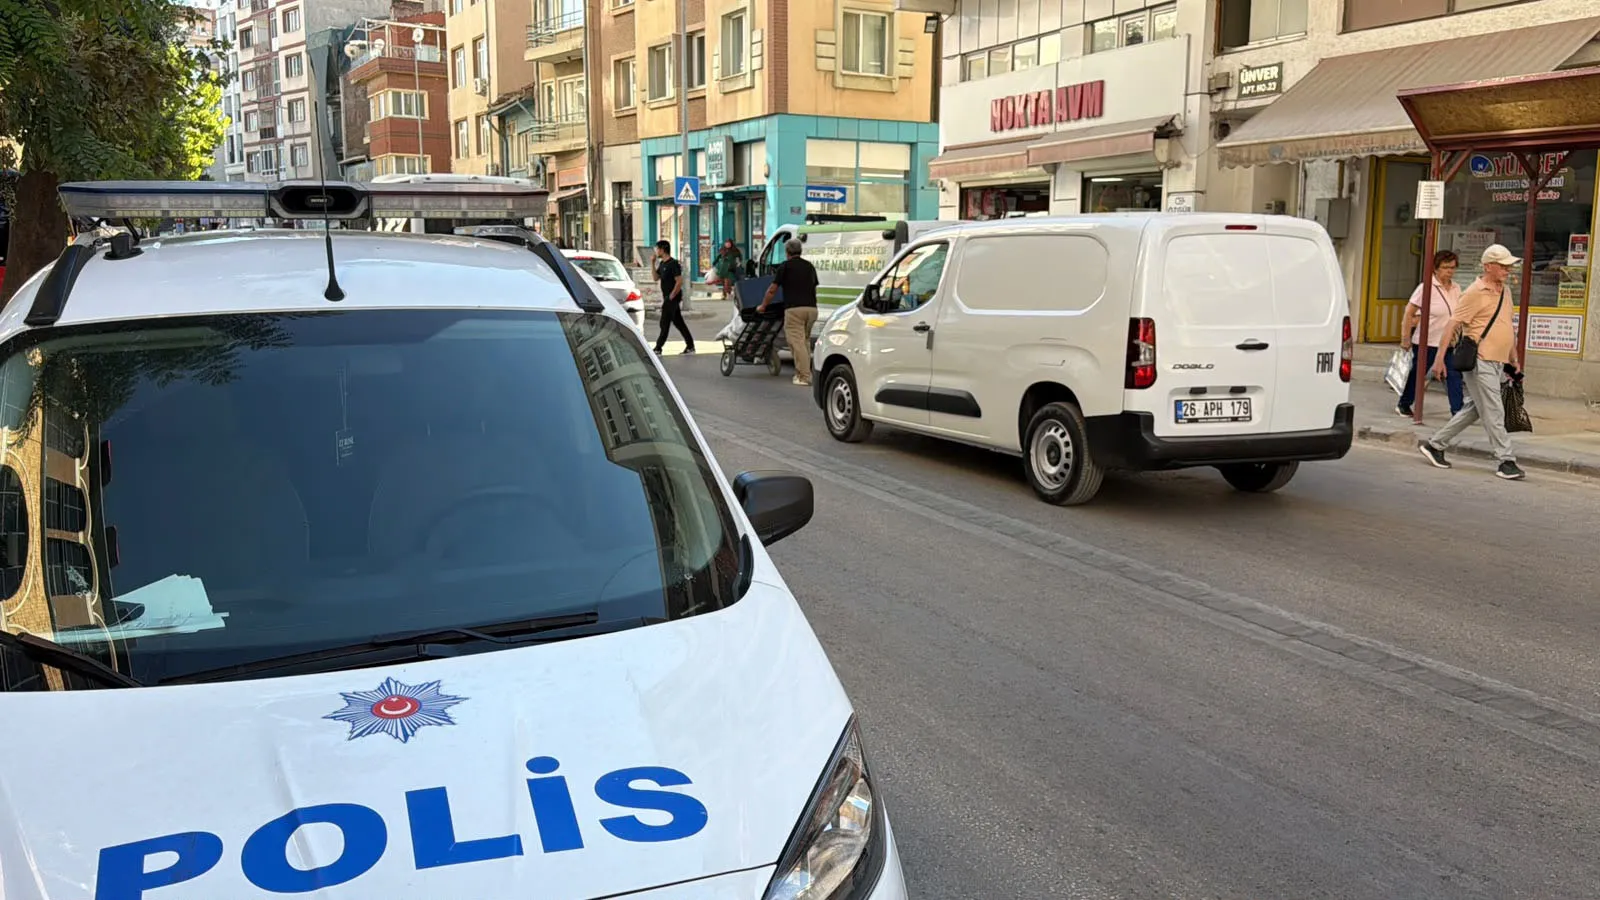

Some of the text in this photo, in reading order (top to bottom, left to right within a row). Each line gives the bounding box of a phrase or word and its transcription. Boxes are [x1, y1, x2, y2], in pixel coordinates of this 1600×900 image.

[1240, 66, 1279, 84] ÜNVER
[990, 80, 1104, 133] NOKTA AVM
[1316, 352, 1335, 373] FIAT
[1183, 401, 1249, 417] 26 APH 179
[95, 756, 708, 900] POLİS
